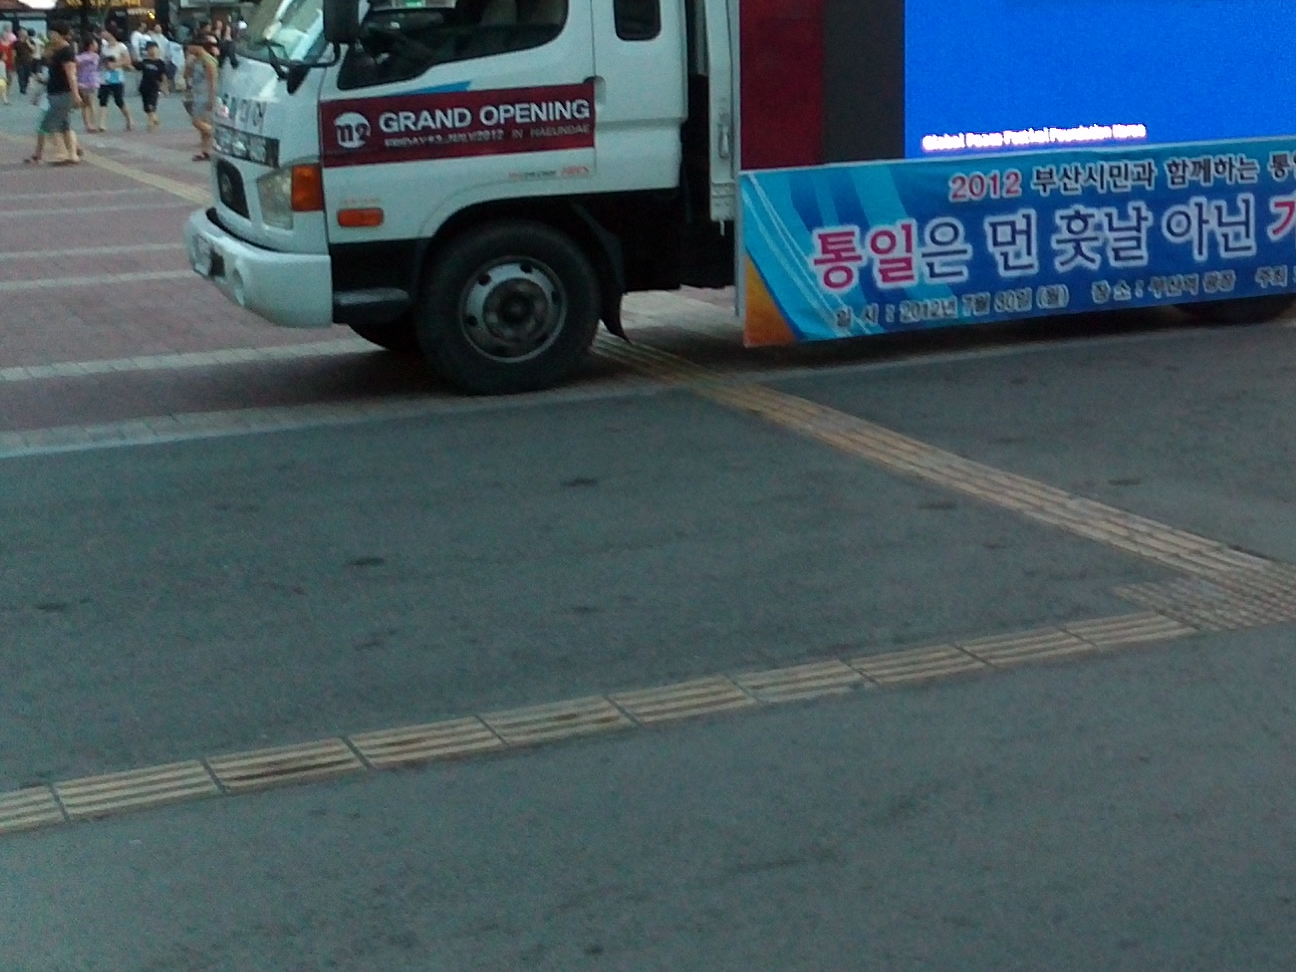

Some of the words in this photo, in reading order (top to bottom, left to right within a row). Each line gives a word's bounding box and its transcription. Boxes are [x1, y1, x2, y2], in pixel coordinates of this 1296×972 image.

[379, 108, 472, 133] GRAND
[480, 99, 591, 127] OPENING
[950, 169, 1023, 201] 2012
[1032, 160, 1157, 197] 부산시민과
[1166, 156, 1258, 190] 함께하는
[812, 218, 973, 291] 통일은
[986, 208, 1038, 277] 먼
[1054, 200, 1154, 271] 훗날
[1163, 193, 1257, 261] 아닌
